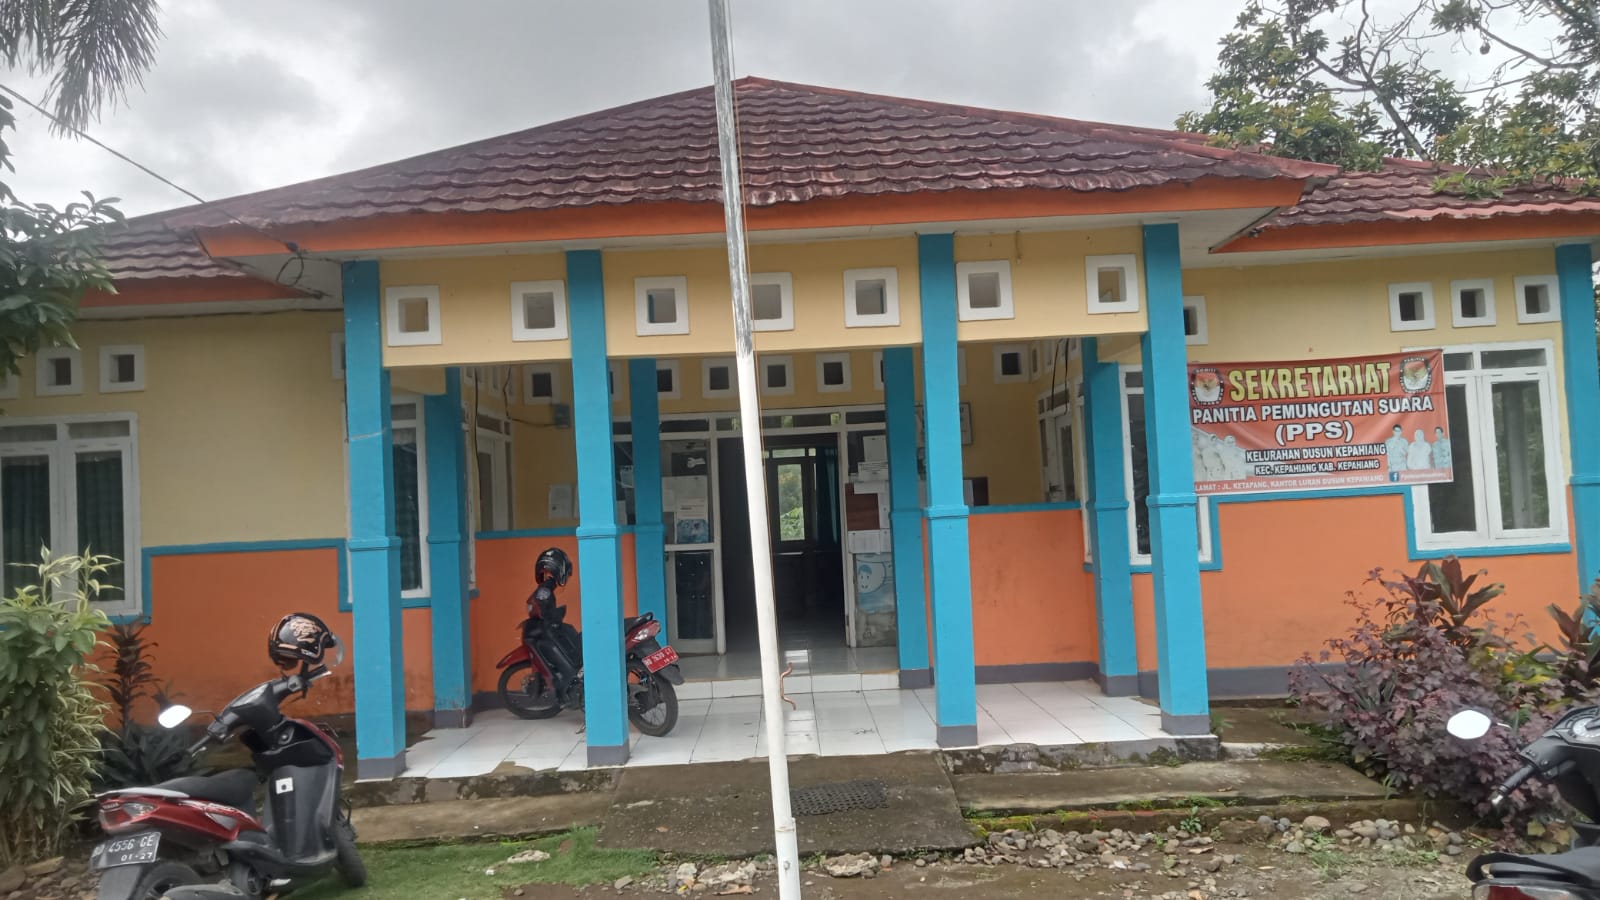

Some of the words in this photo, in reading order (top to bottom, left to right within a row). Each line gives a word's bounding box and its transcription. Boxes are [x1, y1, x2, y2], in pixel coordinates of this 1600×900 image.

[1228, 362, 1391, 402] SEKRETARIAT
[1193, 406, 1257, 424] PANITIA
[1261, 400, 1374, 421] PEMUNGUTAN
[1379, 395, 1433, 414] SUARA
[1275, 420, 1353, 446] (PPS)
[1246, 448, 1300, 462] KELURAHAN
[1302, 447, 1333, 459] DUSUN
[1335, 444, 1386, 457] KEPAHIANG
[1255, 465, 1272, 475] KEC.
[1274, 463, 1317, 474] KEPAHIANG
[1318, 462, 1336, 472] KAB.
[1338, 460, 1379, 471] KEPAHIANG
[1270, 480, 1297, 488] KANTOR
[1322, 477, 1345, 485] DUSUN
[108, 838, 135, 853] 4556
[140, 834, 155, 847] GE
